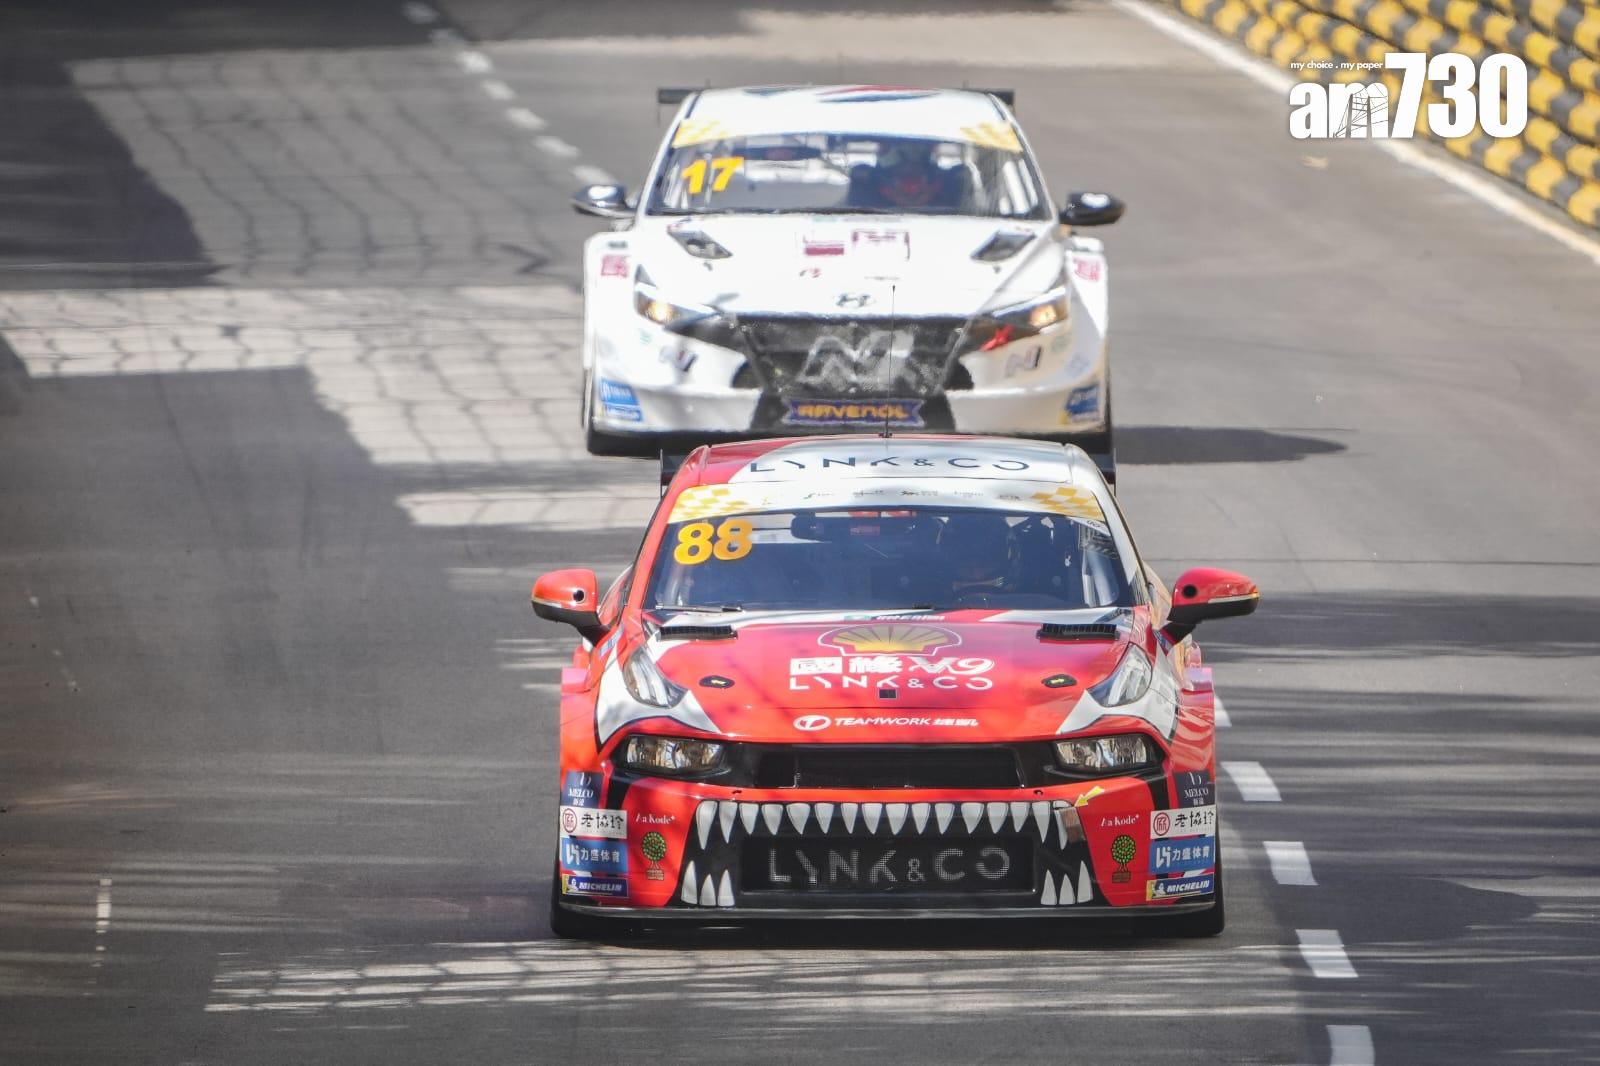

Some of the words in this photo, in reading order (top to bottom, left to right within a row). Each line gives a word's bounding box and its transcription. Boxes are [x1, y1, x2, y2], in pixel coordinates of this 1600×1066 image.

[681, 156, 744, 194] 17
[673, 519, 753, 565] 88
[834, 717, 932, 726] TEAMWORK
[578, 881, 622, 892] MICHELIN
[1167, 880, 1210, 893] MICHELIN
